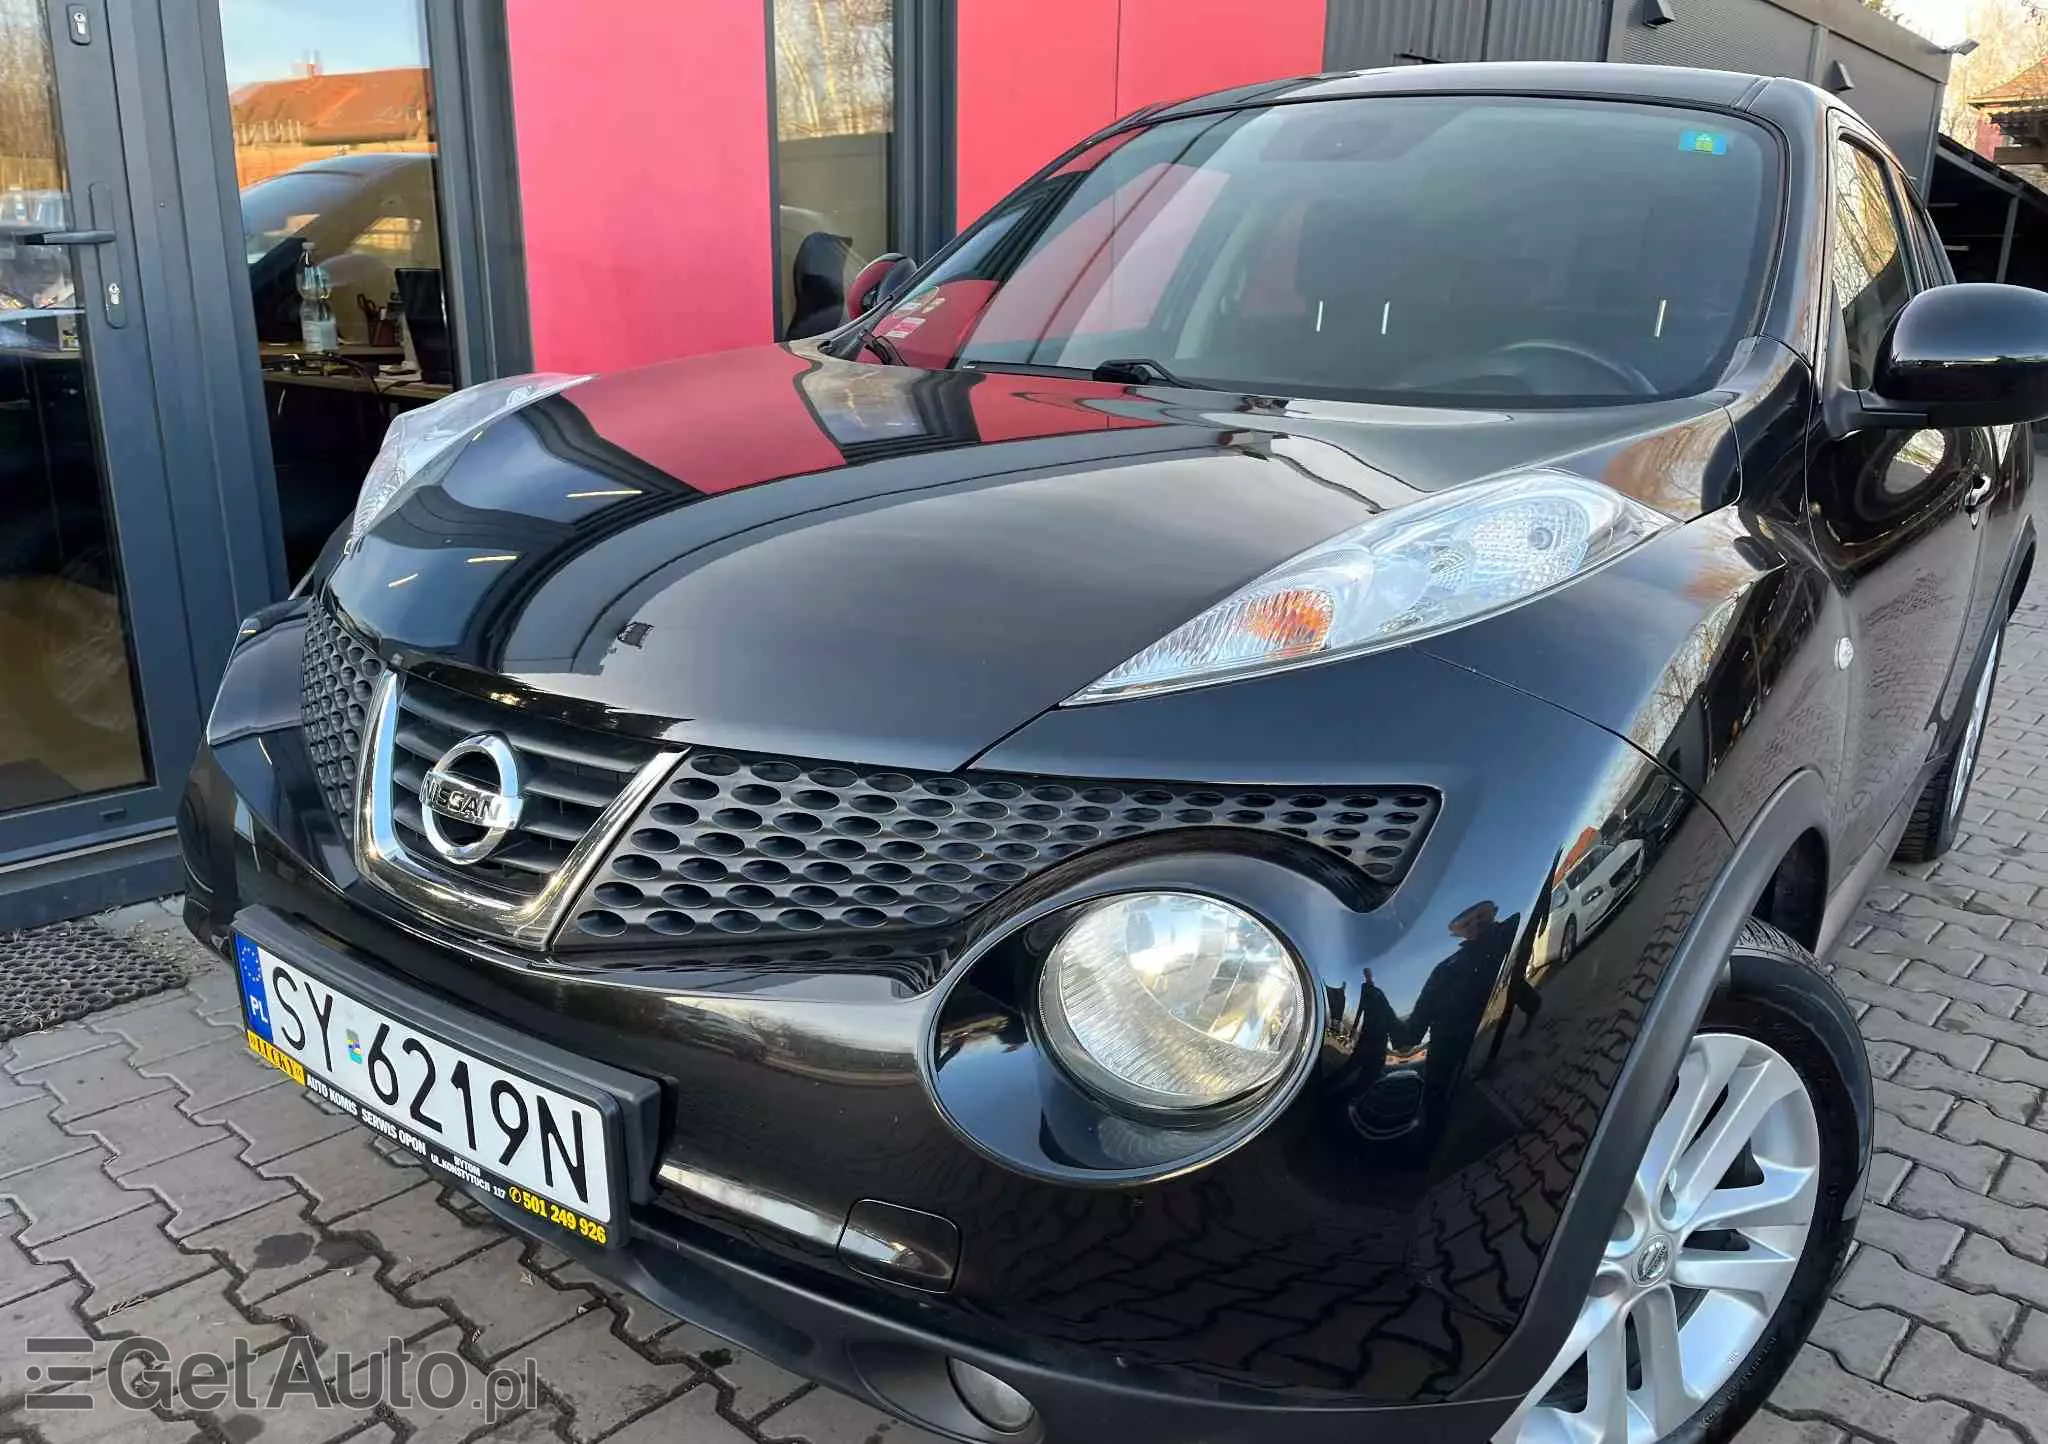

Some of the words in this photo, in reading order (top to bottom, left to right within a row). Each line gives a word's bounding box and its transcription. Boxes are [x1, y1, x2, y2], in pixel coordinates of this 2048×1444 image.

[250, 995, 269, 1025] PL
[271, 965, 334, 1073] SY
[367, 1022, 589, 1204] 6219N
[306, 1074, 328, 1098] AUTO
[329, 1087, 358, 1116] KOMIS
[361, 1107, 398, 1140] SERWIS
[399, 1128, 427, 1156] OPON
[522, 1190, 548, 1218] 501
[550, 1204, 577, 1231] 249
[579, 1219, 607, 1245] 926
